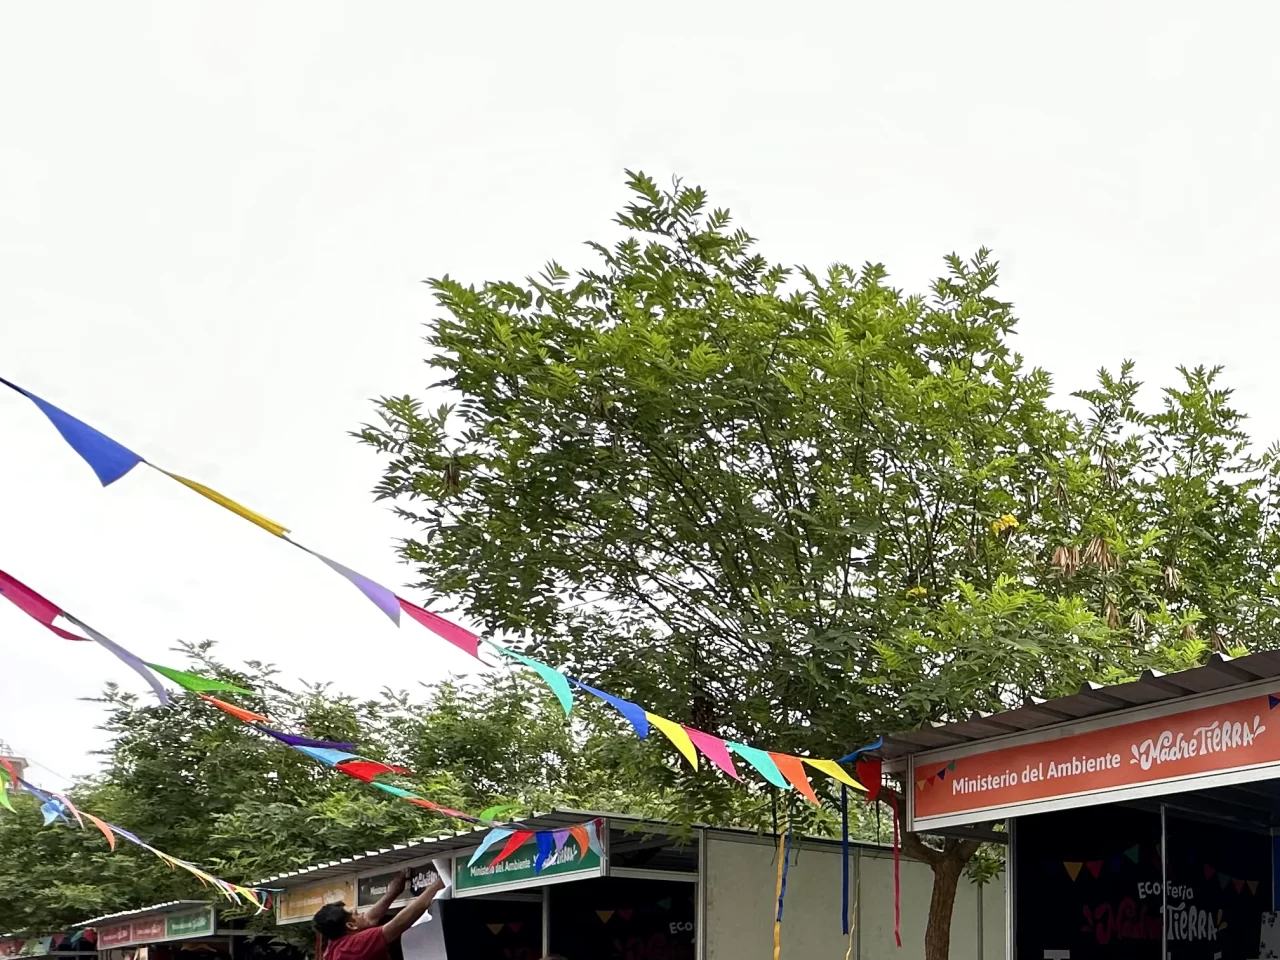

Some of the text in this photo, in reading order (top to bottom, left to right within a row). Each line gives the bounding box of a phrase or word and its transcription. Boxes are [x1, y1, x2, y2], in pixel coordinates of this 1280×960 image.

[952, 769, 1018, 796] Ministerio
[1021, 764, 1044, 784] del
[1046, 752, 1121, 780] Ambiente
[1140, 730, 1198, 771] Madre
[504, 859, 530, 871] Ambiente
